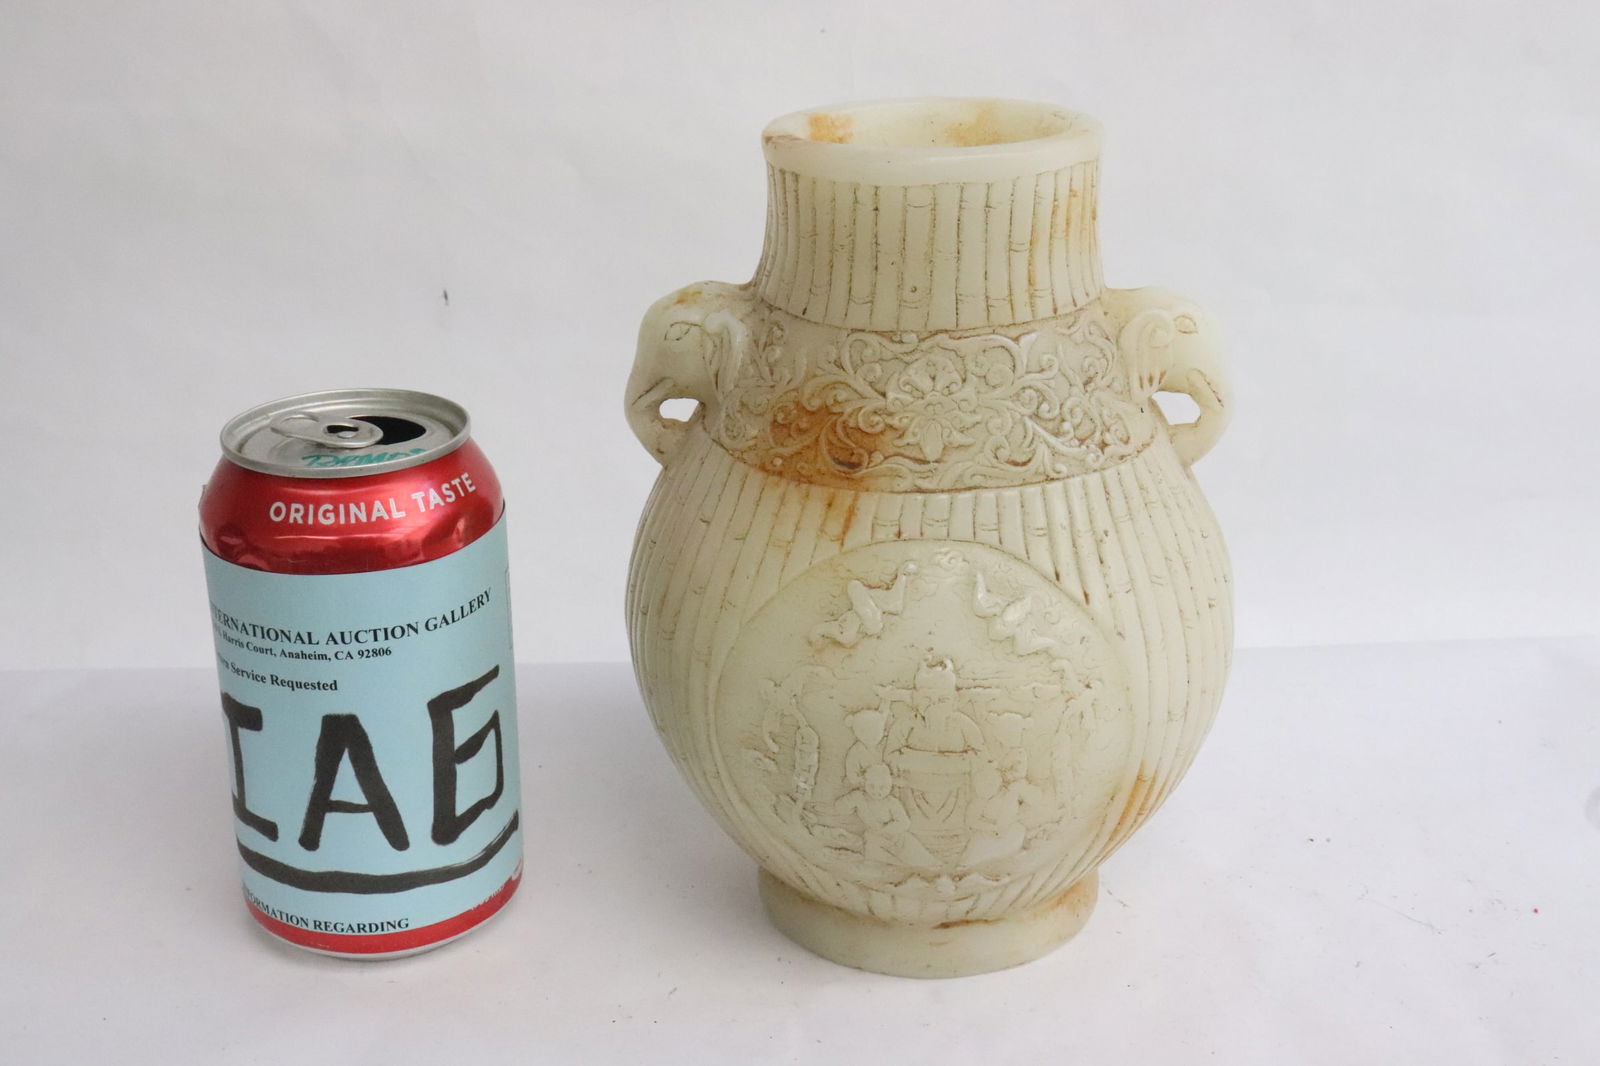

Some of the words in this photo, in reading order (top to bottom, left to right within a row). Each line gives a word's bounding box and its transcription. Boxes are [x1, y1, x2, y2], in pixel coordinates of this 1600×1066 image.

[268, 501, 407, 525] ORIGINAL
[411, 471, 477, 513] TASTE
[212, 604, 320, 646] TERNATIONAL
[326, 621, 419, 646] AUCTION
[424, 586, 491, 632] GALLERY
[246, 641, 277, 657] Court,
[279, 648, 332, 662] Anaheim,
[334, 650, 354, 661] CA
[357, 646, 392, 660] 92806
[230, 662, 267, 684] Service
[269, 674, 338, 692] Requested
[247, 890, 309, 928] FORMATION
[313, 918, 409, 934] REGARDING
